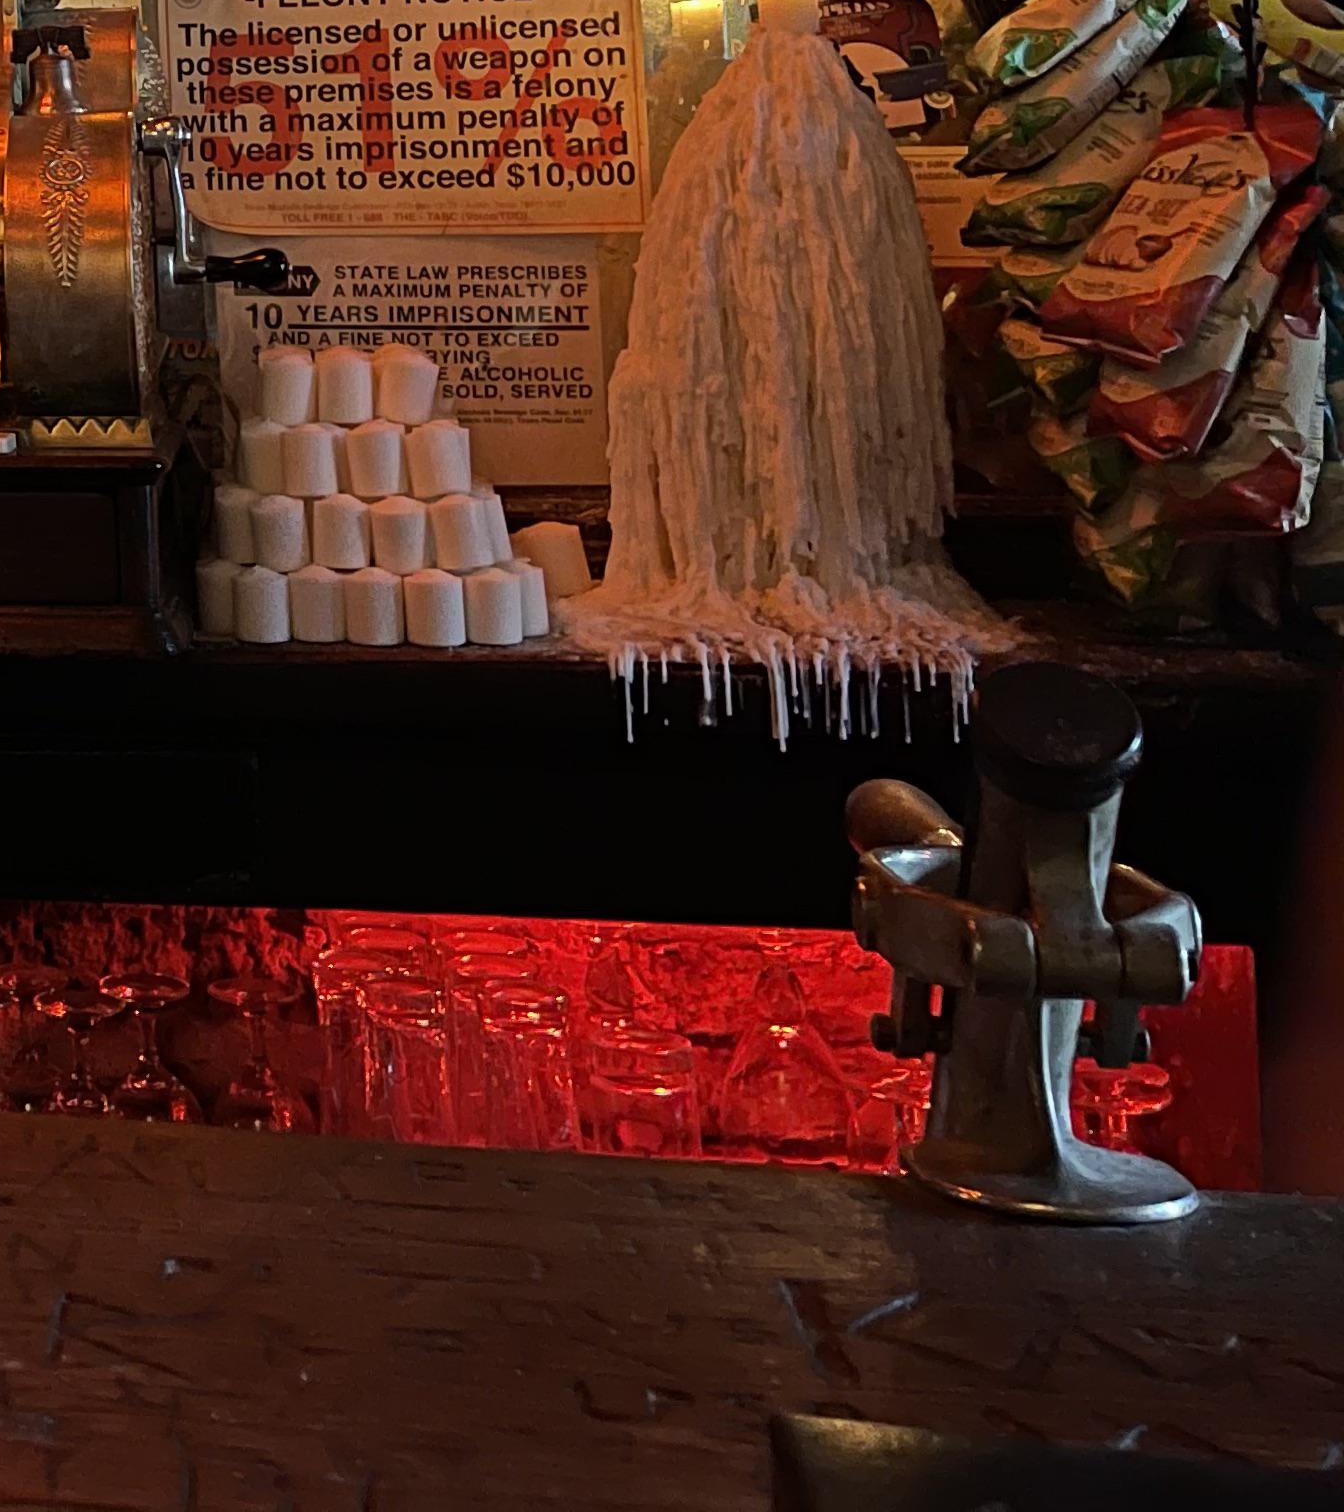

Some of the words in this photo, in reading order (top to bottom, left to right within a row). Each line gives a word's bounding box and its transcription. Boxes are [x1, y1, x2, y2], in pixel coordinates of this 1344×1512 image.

[178, 23, 236, 47] The
[248, 19, 381, 46] licensed
[393, 22, 426, 41] or
[438, 12, 621, 41] unlicensed
[177, 47, 360, 81] possession
[373, 46, 403, 72] of
[414, 51, 431, 71] a
[443, 47, 571, 79] weapon
[583, 47, 625, 66] on
[188, 81, 274, 105] these
[285, 80, 433, 114] premises
[446, 77, 471, 99] is
[484, 81, 502, 99] a
[513, 73, 617, 106] felony
[184, 108, 248, 133] with
[259, 112, 276, 132] a
[288, 105, 447, 132] maximum
[458, 103, 580, 137] penalty
[593, 101, 624, 126] of
[184, 139, 213, 162] 10
[227, 142, 315, 167] years
[326, 134, 555, 167] imprisonment
[566, 132, 628, 156] and
[180, 171, 195, 188] a
[206, 167, 263, 189] fine
[275, 167, 324, 189] not
[337, 167, 367, 188] to
[379, 161, 496, 188] exceed
[507, 160, 635, 191] $10,000
[334, 266, 400, 280] STATE
[407, 266, 448, 280] LAW
[458, 265, 587, 280] PRESCRIBES
[333, 285, 345, 297] A
[352, 284, 450, 298] MAXIMUM
[458, 284, 555, 298] PENALTY
[560, 284, 589, 298] OF
[246, 304, 283, 329] 10
[297, 306, 378, 322] YEARS
[389, 306, 589, 323] IMPRISONMENT
